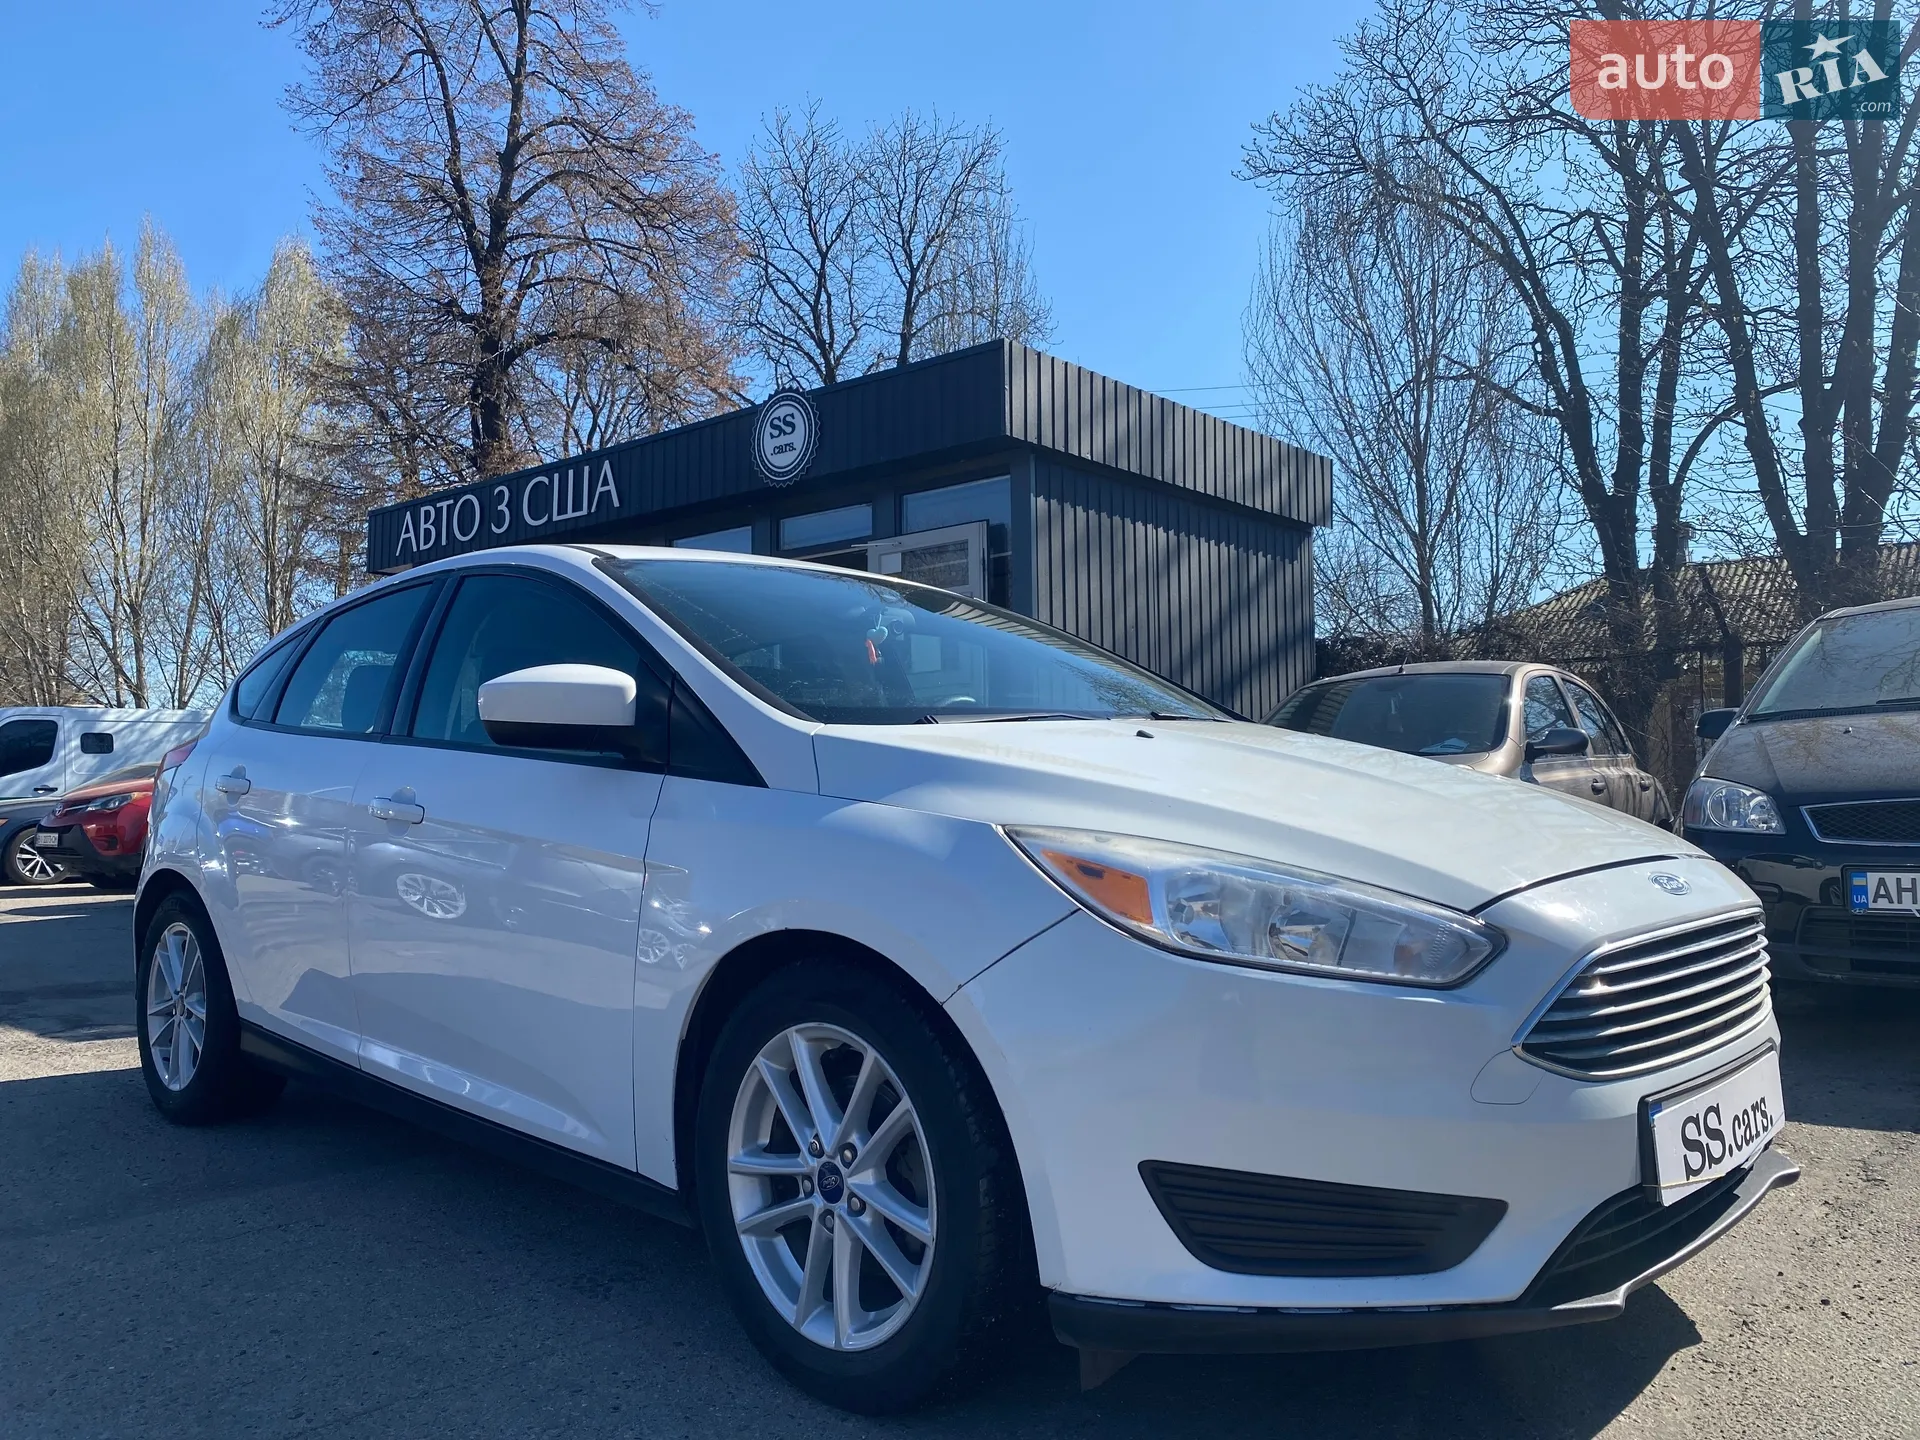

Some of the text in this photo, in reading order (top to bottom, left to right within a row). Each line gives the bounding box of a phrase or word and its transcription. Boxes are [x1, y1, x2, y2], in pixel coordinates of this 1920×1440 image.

[769, 412, 796, 440] SS
[770, 442, 797, 456] .cars.
[396, 460, 620, 557] АВТО З США
[1853, 894, 1868, 904] UA
[1871, 876, 1918, 905] AH
[1681, 1096, 1774, 1181] SS.cars.
